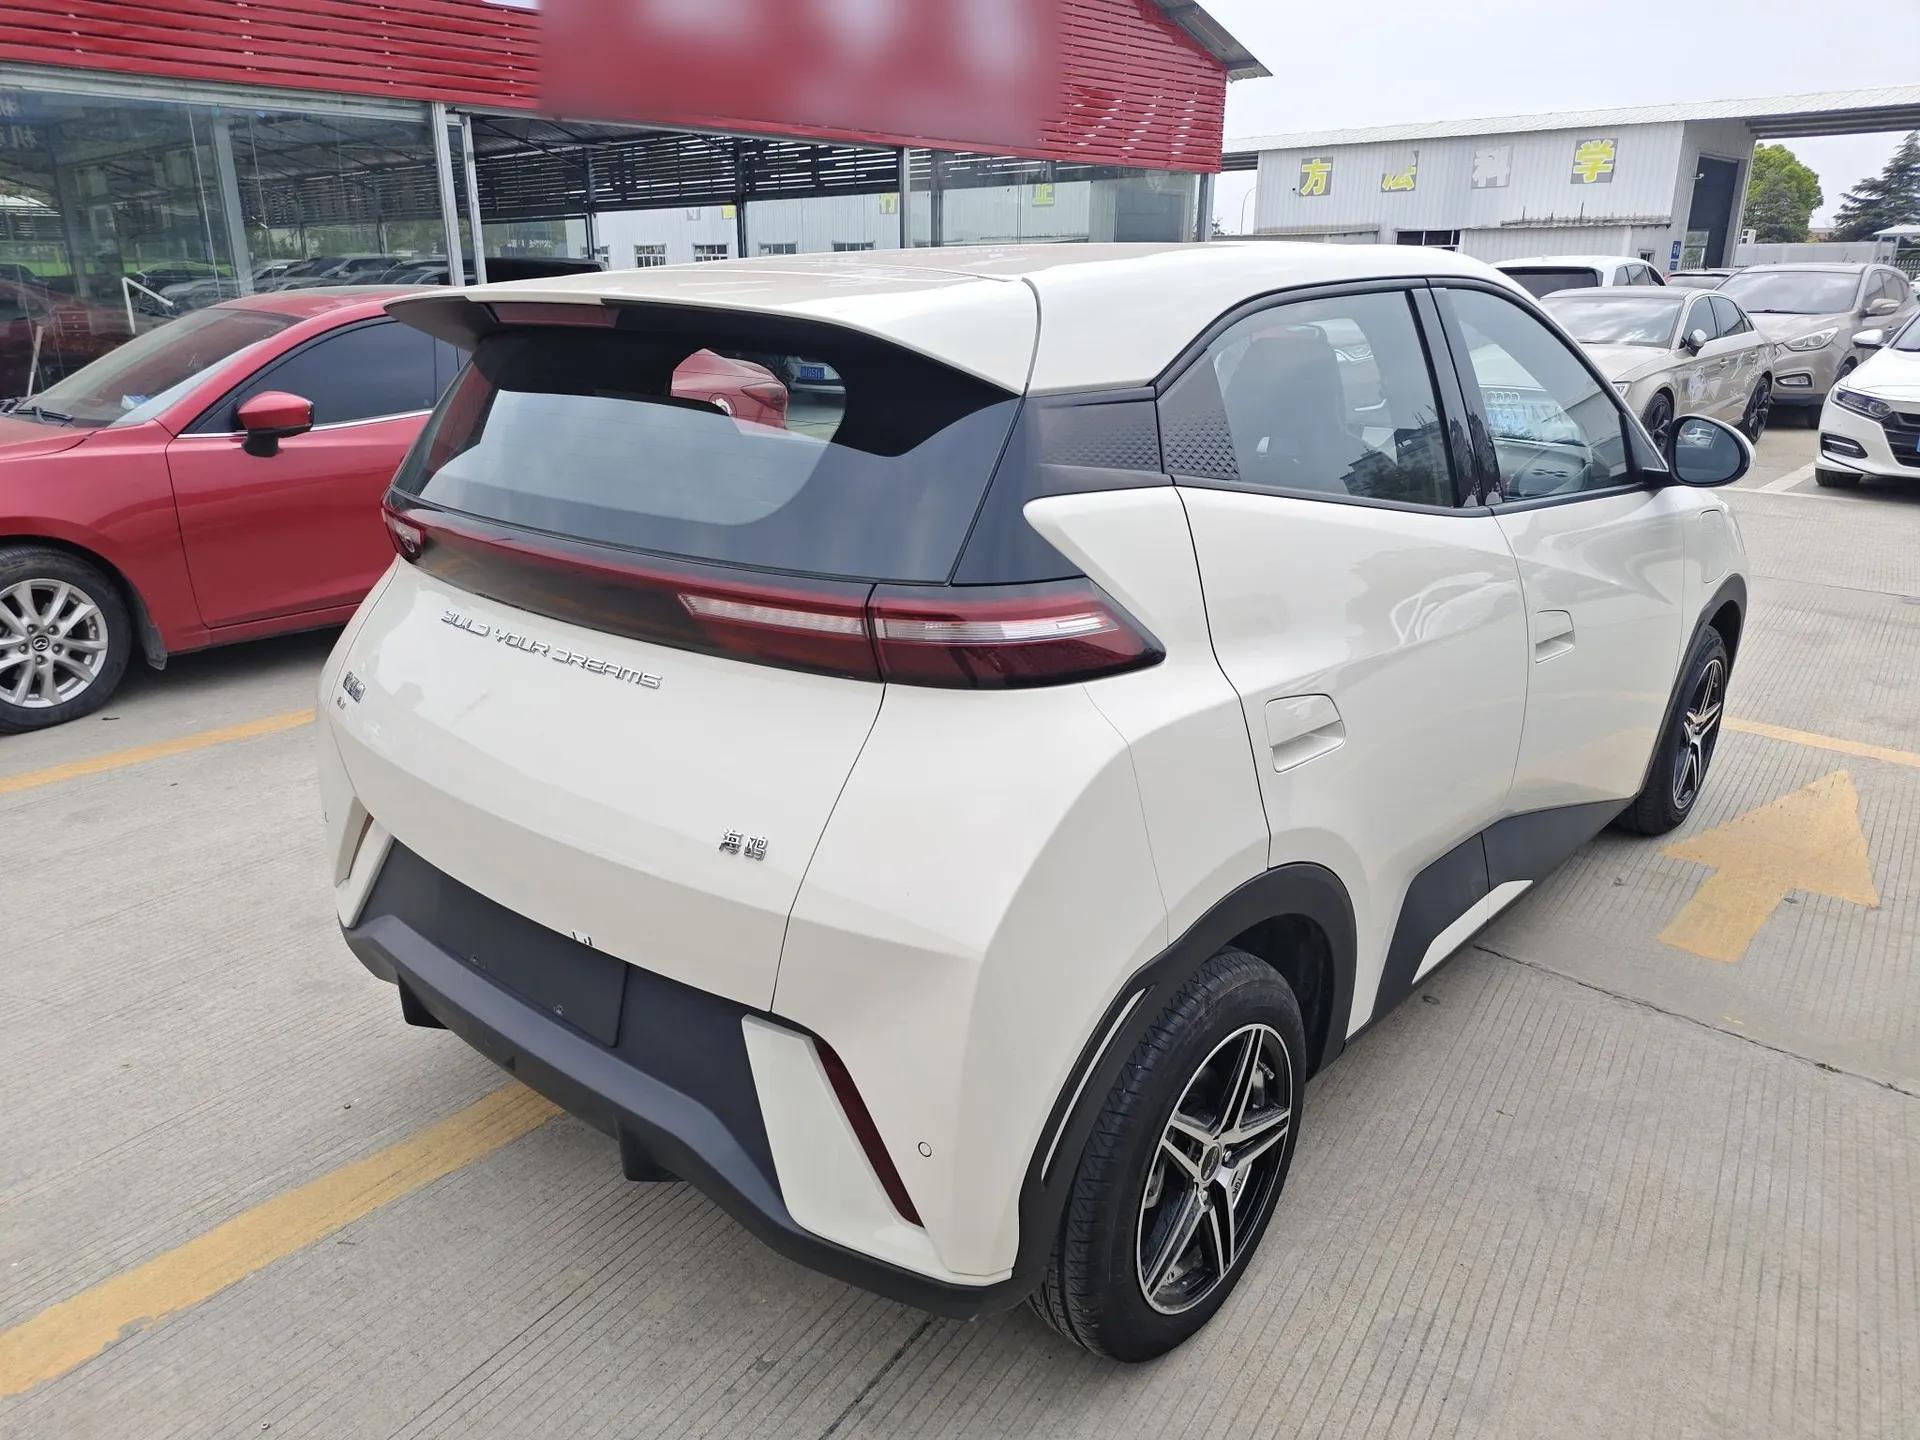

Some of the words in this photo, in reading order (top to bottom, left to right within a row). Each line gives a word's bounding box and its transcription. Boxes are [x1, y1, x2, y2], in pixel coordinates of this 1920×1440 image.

[441, 611, 490, 636] BUILD
[495, 628, 549, 657] YOUR
[552, 648, 662, 689] DREAMS
[719, 828, 768, 861] 海鸥
